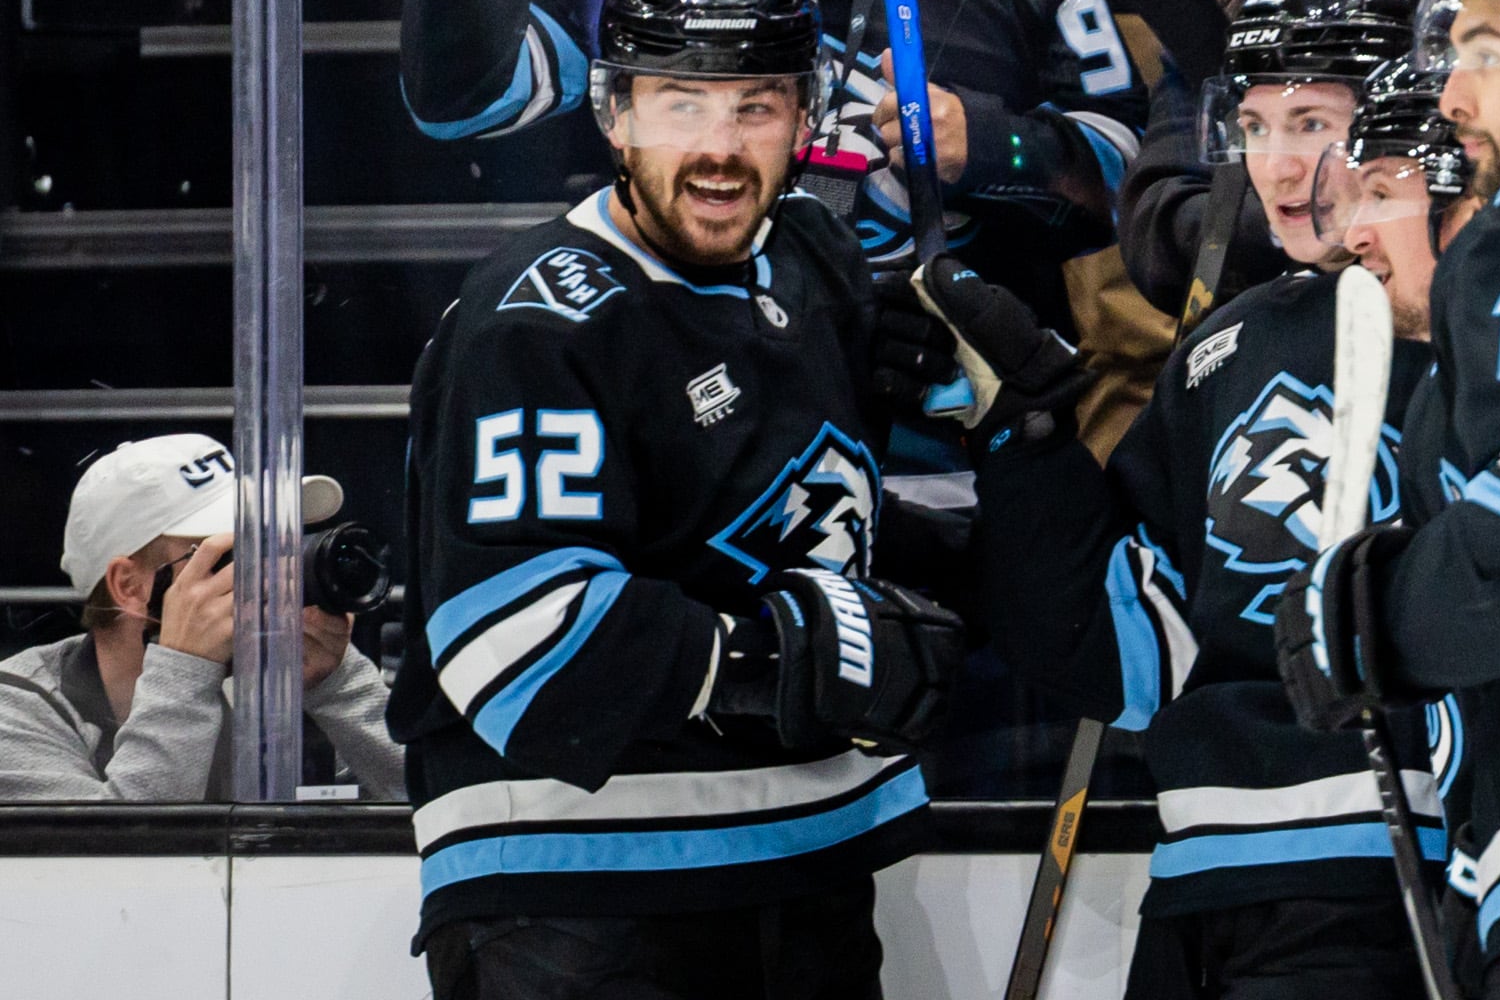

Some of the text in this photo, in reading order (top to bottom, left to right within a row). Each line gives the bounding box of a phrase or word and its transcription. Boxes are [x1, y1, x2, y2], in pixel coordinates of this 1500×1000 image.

[684, 18, 758, 30] WARRIOR
[1230, 28, 1281, 48] CCM
[548, 252, 598, 304] UTAH
[1194, 335, 1231, 369] SME
[180, 449, 233, 489] UT
[467, 407, 606, 524] 52
